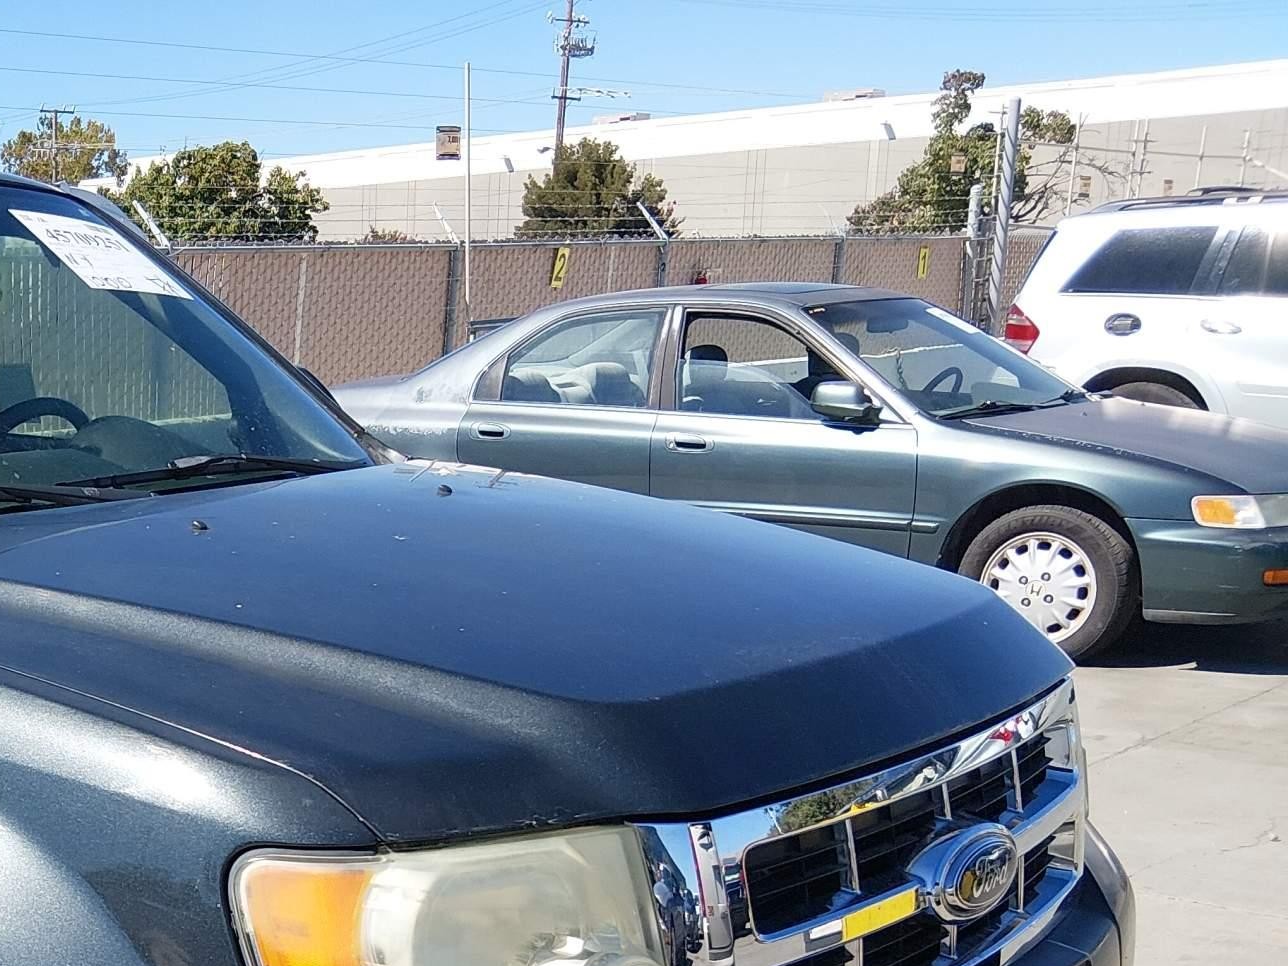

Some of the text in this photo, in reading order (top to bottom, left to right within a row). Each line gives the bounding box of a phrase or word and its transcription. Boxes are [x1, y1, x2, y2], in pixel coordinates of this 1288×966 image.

[44, 228, 131, 252] 45709251
[553, 253, 567, 282] 2
[921, 251, 927, 275] 1
[973, 846, 1011, 898] Ford
